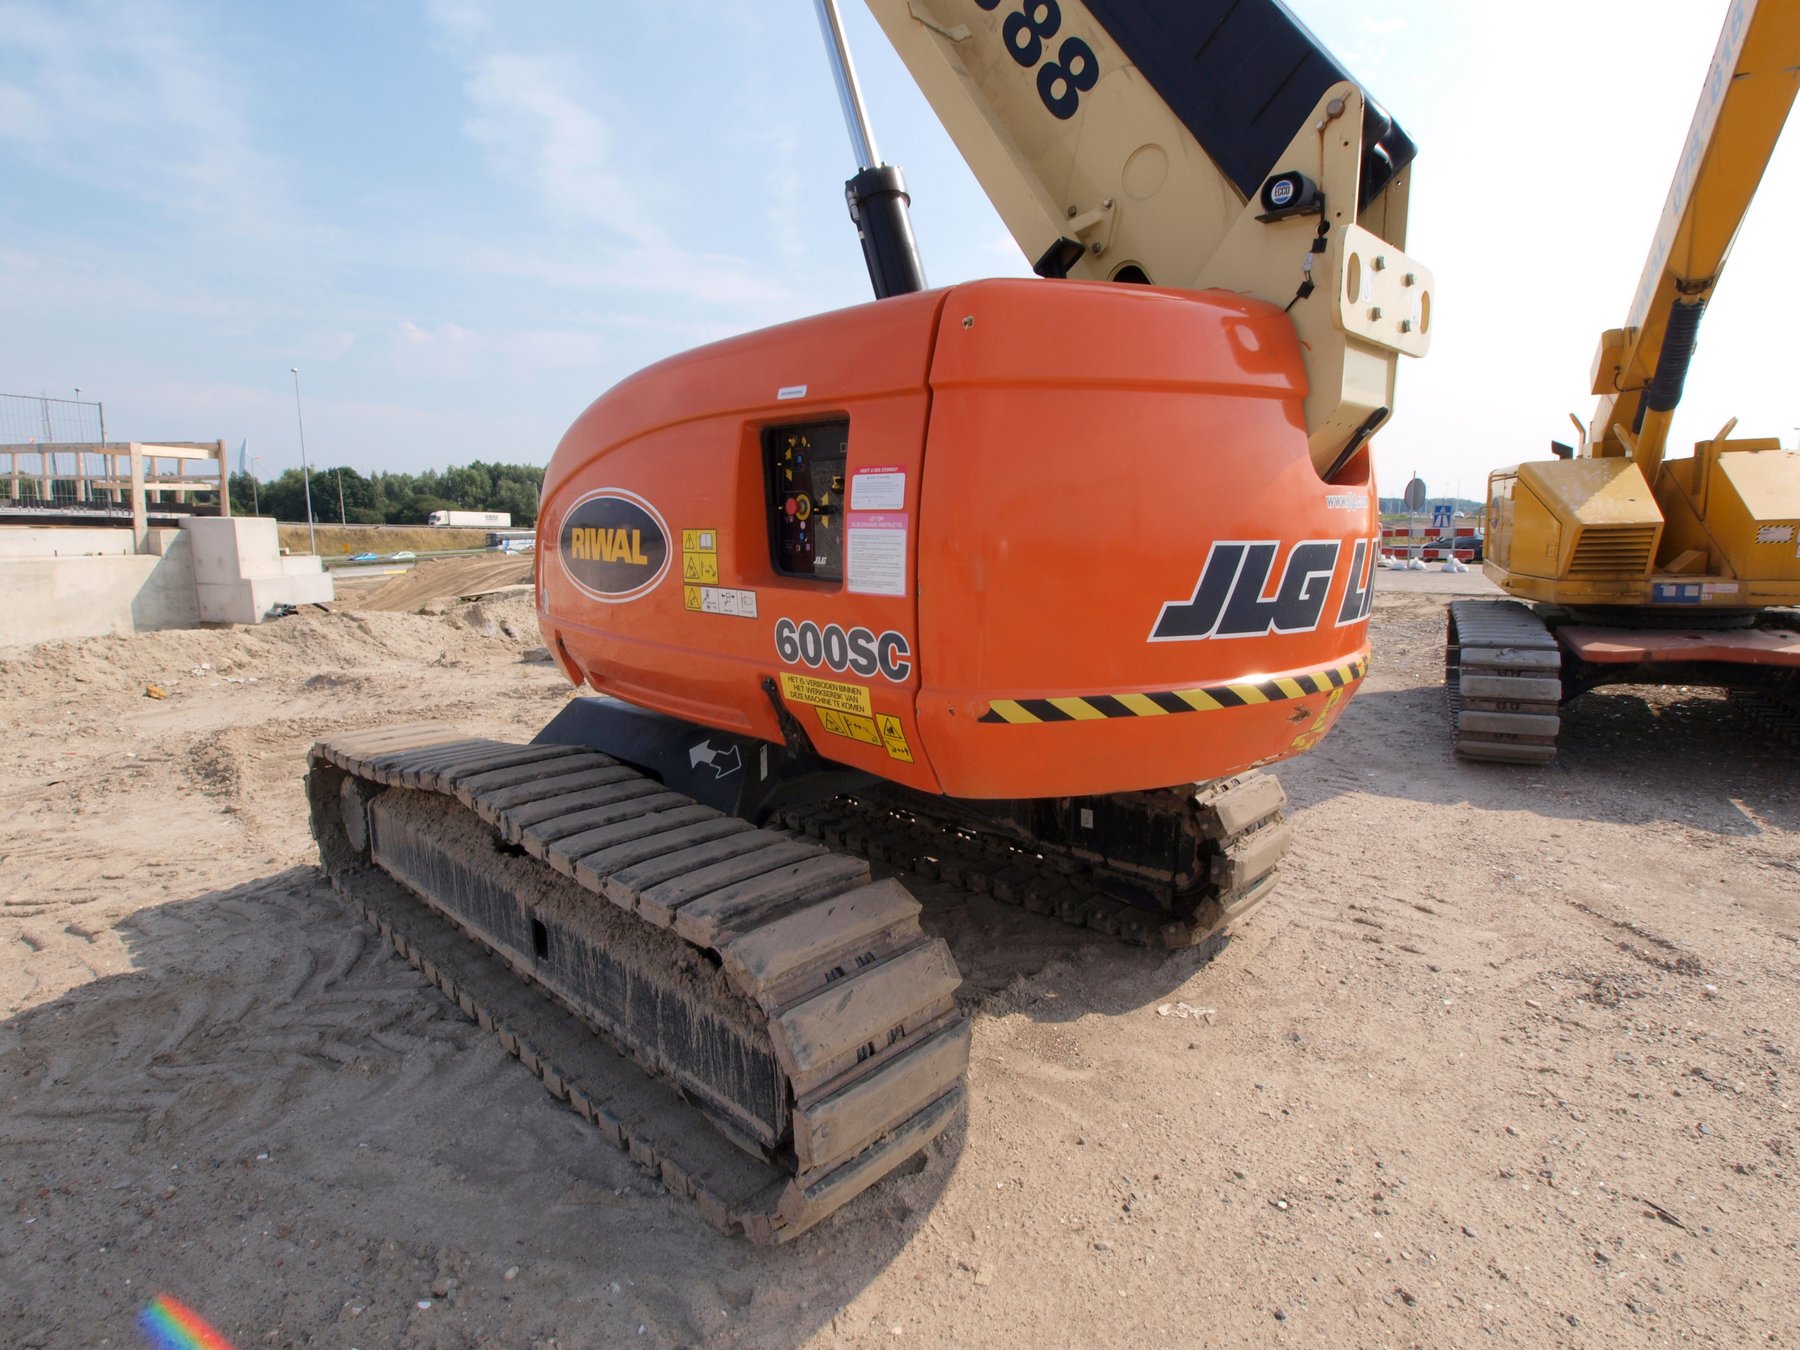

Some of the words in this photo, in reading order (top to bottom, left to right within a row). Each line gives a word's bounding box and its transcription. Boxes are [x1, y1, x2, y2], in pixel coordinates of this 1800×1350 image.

[974, 0, 1099, 120] 88
[1274, 185, 1290, 197] ECCO
[572, 527, 648, 566] RIWAL
[813, 556, 827, 565] JLG
[1146, 539, 1342, 643] JLG
[1334, 537, 1379, 628] LI
[774, 616, 911, 683] 600SC
[787, 675, 799, 684] HET
[799, 677, 806, 685] IS
[806, 679, 837, 691] VERBODEN
[839, 685, 861, 695] BINNEN
[793, 684, 805, 692] HET
[805, 686, 844, 700] WERKBEREIK
[844, 694, 859, 704] VAN
[789, 690, 803, 700] DEZE
[805, 694, 832, 705] MACHINE
[833, 699, 841, 708] TE
[841, 702, 864, 712] KOMEN
